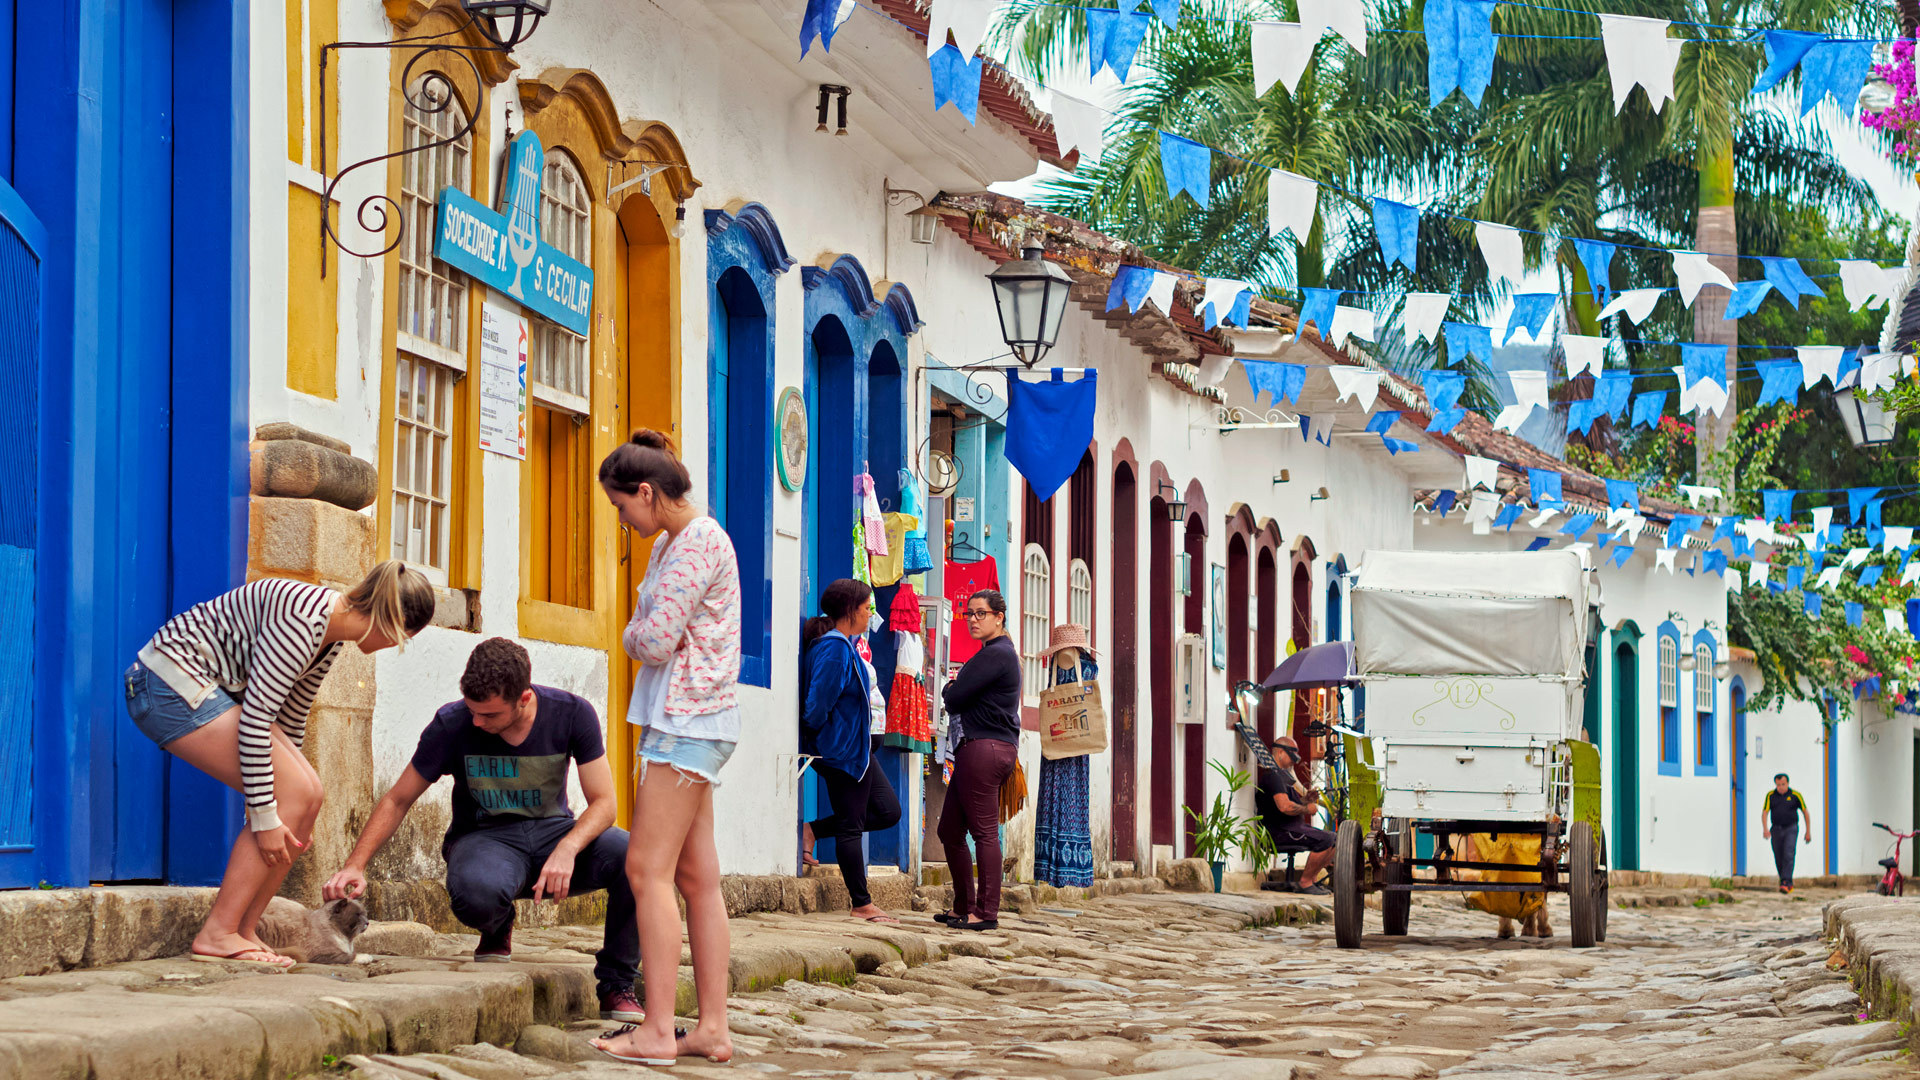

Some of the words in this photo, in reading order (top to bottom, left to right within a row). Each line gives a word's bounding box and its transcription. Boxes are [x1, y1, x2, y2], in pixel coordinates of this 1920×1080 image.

[444, 203, 499, 267] SOCIEDADE
[497, 233, 508, 272] M.
[534, 256, 544, 292] S.
[546, 263, 591, 318] CECILIA
[1047, 694, 1086, 708] PARATY
[1455, 683, 1475, 704] 12
[466, 756, 520, 778] EARLY
[470, 788, 543, 810] SUMMER
